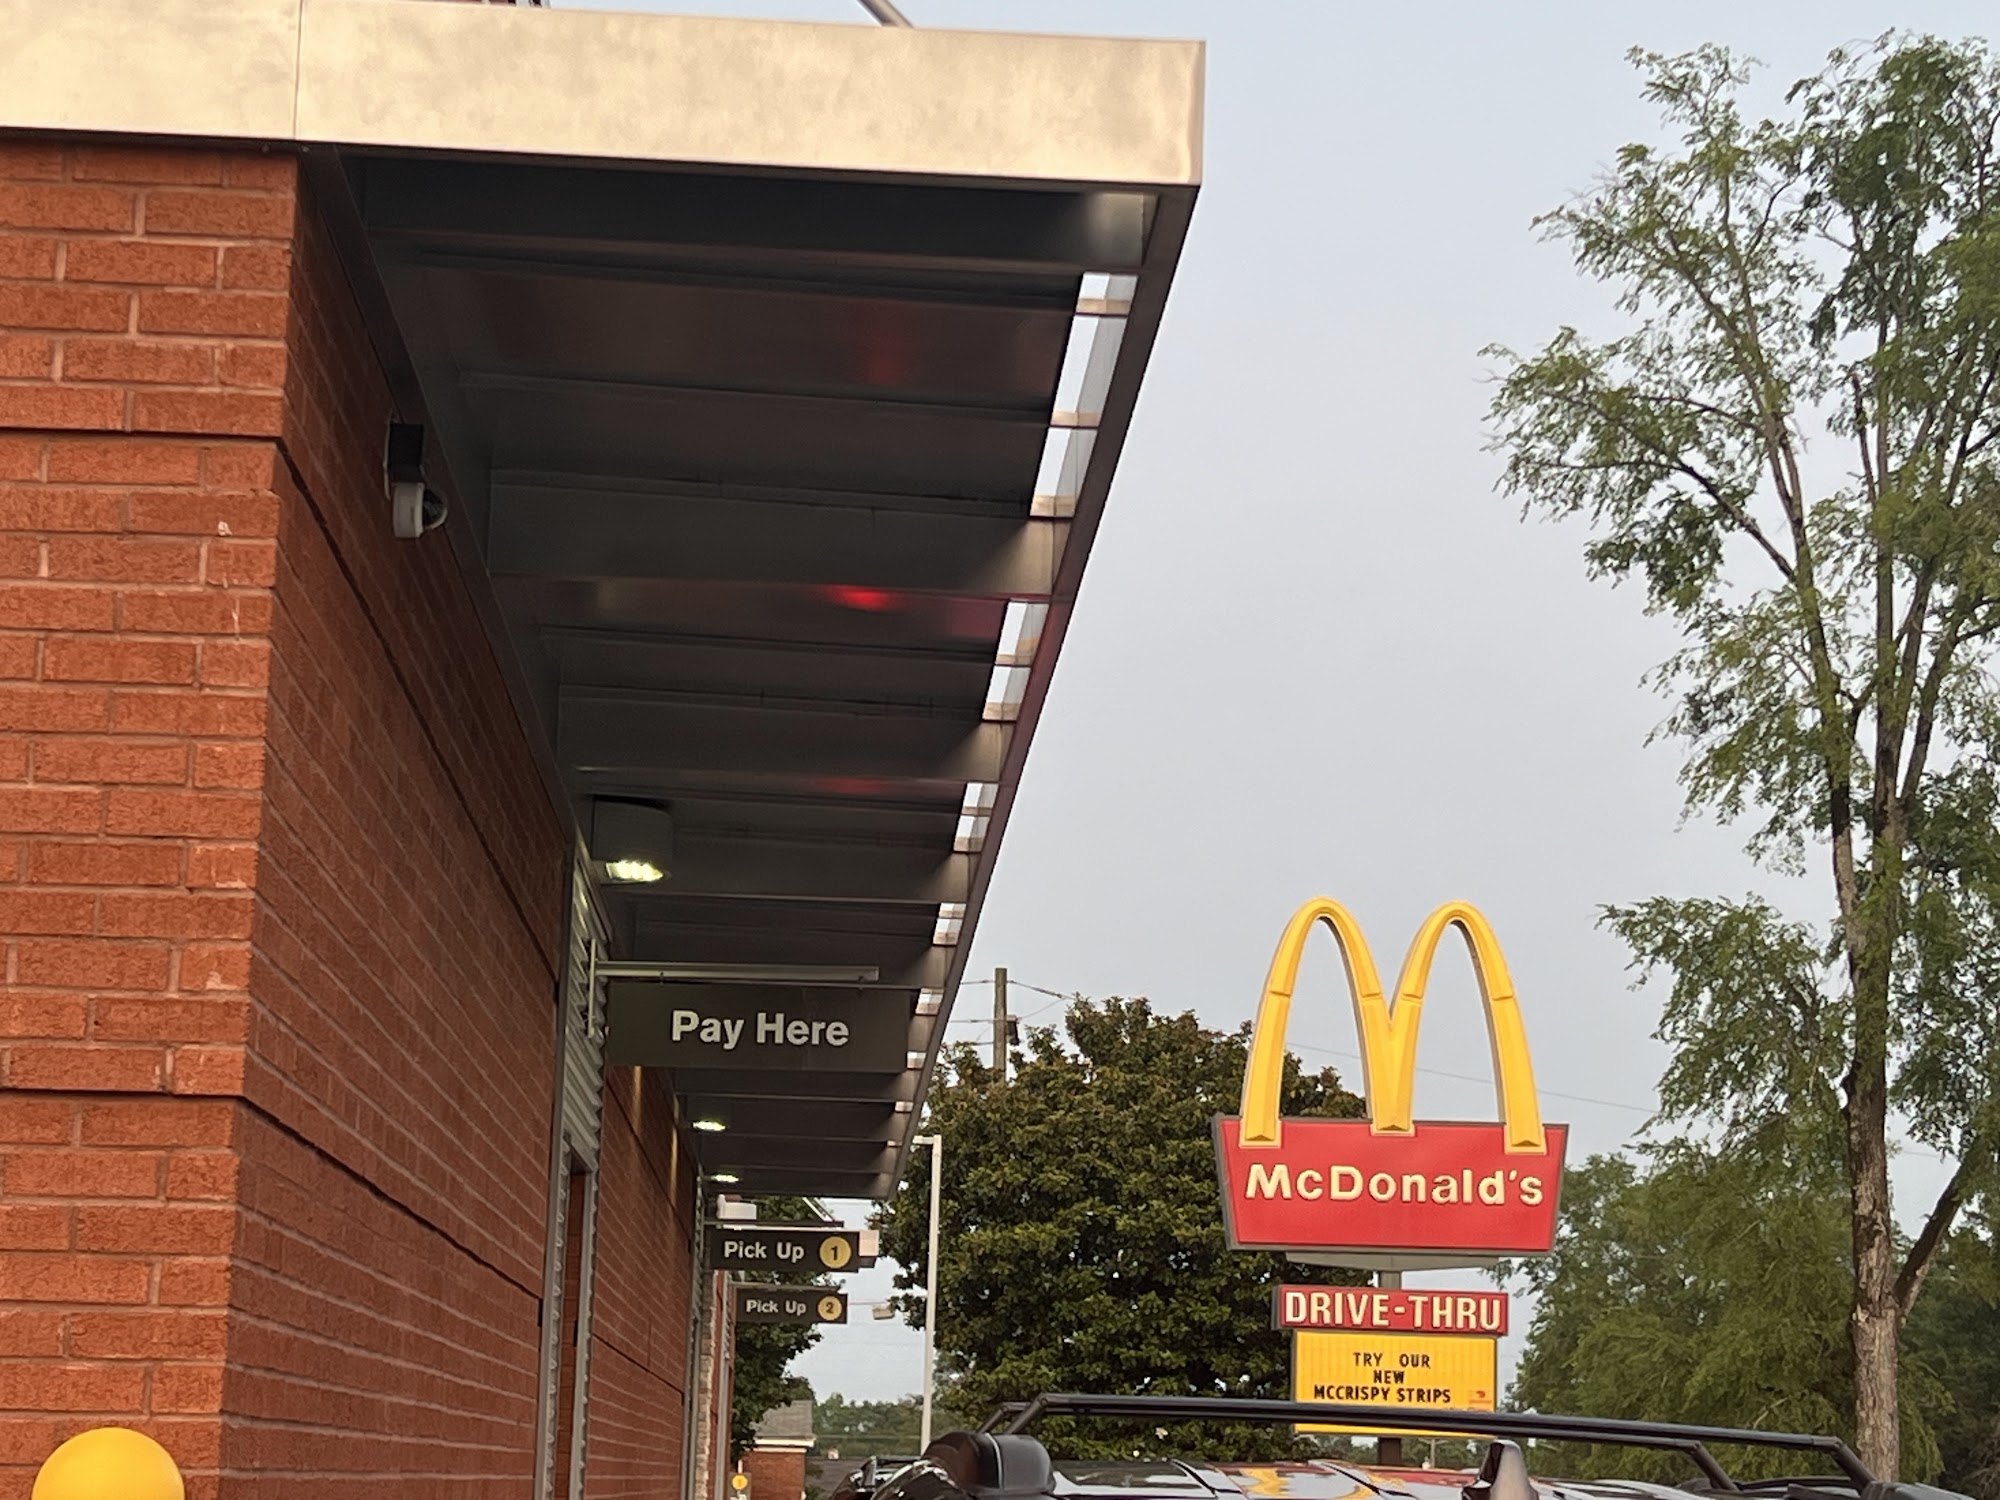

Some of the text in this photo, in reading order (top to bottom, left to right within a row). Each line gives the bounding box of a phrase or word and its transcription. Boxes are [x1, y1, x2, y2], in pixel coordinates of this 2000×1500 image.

[671, 1009, 850, 1050] Pay Here
[1245, 1163, 1544, 1206] McDonald's
[724, 1241, 839, 1263] Pick Up 1
[746, 1299, 835, 1316] Pick Up 2
[1284, 1292, 1501, 1331] DRIVE-THRU
[1353, 1352, 1431, 1368] TRY OUR
[1373, 1369, 1405, 1385] NEW
[1314, 1384, 1451, 1404] MCCRISPY STRIPS
